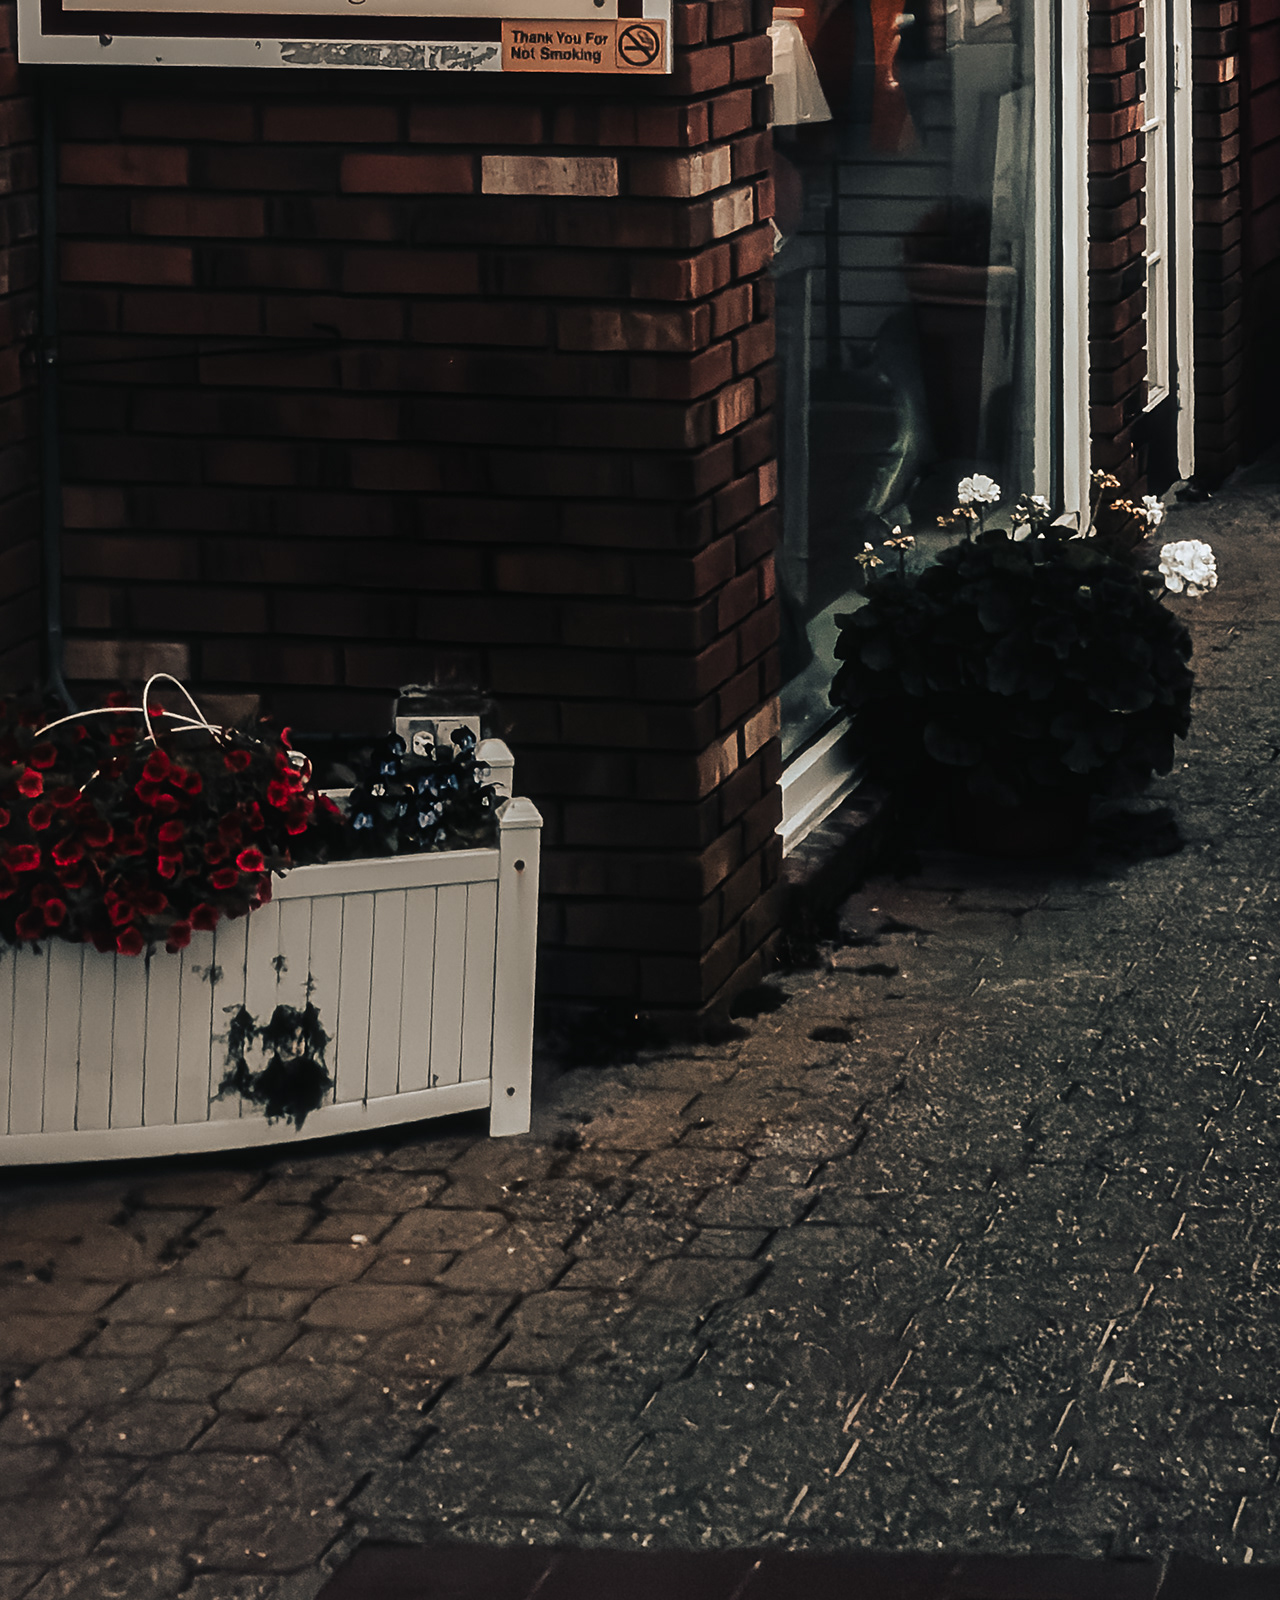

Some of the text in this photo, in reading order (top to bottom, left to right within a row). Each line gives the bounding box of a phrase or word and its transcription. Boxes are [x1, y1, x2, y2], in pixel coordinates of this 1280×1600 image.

[511, 30, 609, 46] Thank You For
[511, 47, 602, 64] Not Smoking
